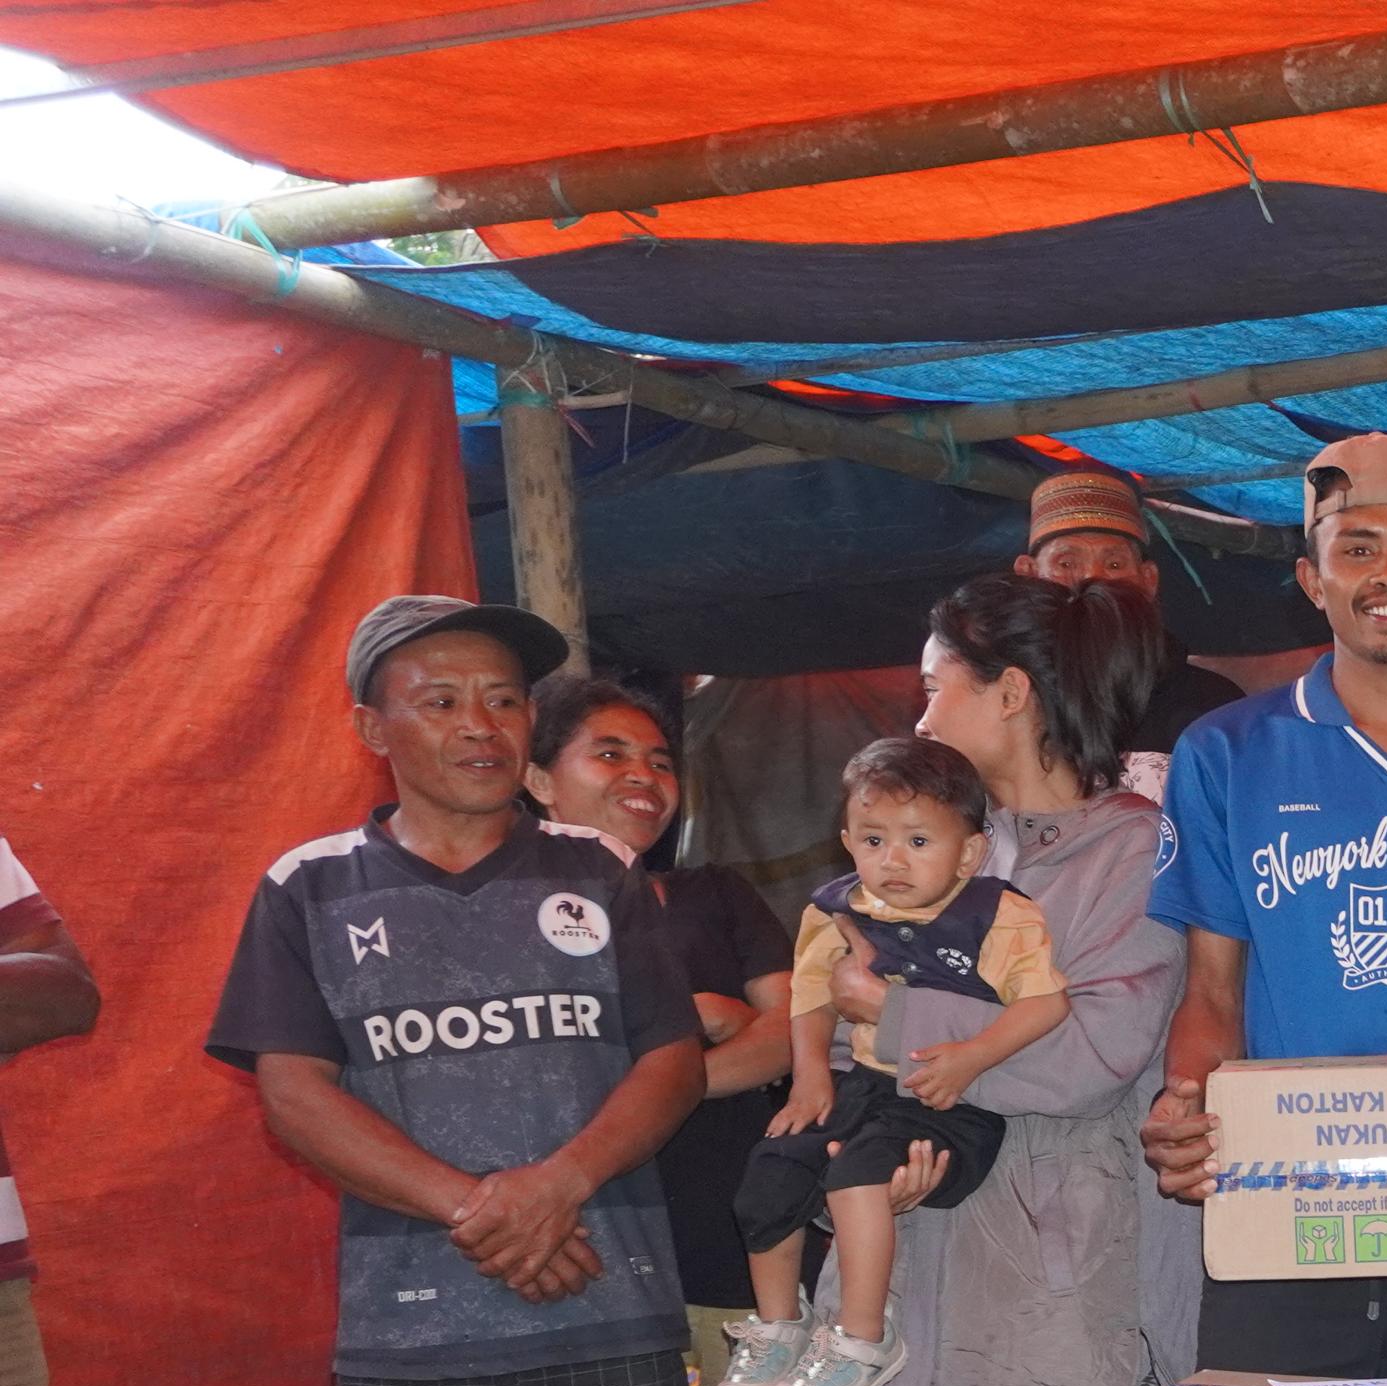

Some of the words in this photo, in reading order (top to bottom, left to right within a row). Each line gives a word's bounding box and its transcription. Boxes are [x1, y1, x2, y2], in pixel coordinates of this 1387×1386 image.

[1279, 803, 1320, 813] BASEBALL
[1358, 896, 1387, 927] 01
[551, 929, 600, 941] ROOSTER
[363, 993, 602, 1062] ROOSTER
[1276, 1090, 1384, 1115] KARTON
[1295, 1197, 1310, 1213] Do
[1313, 1197, 1334, 1213] not
[1336, 1198, 1378, 1216] accept
[1380, 1196, 1387, 1211] if
